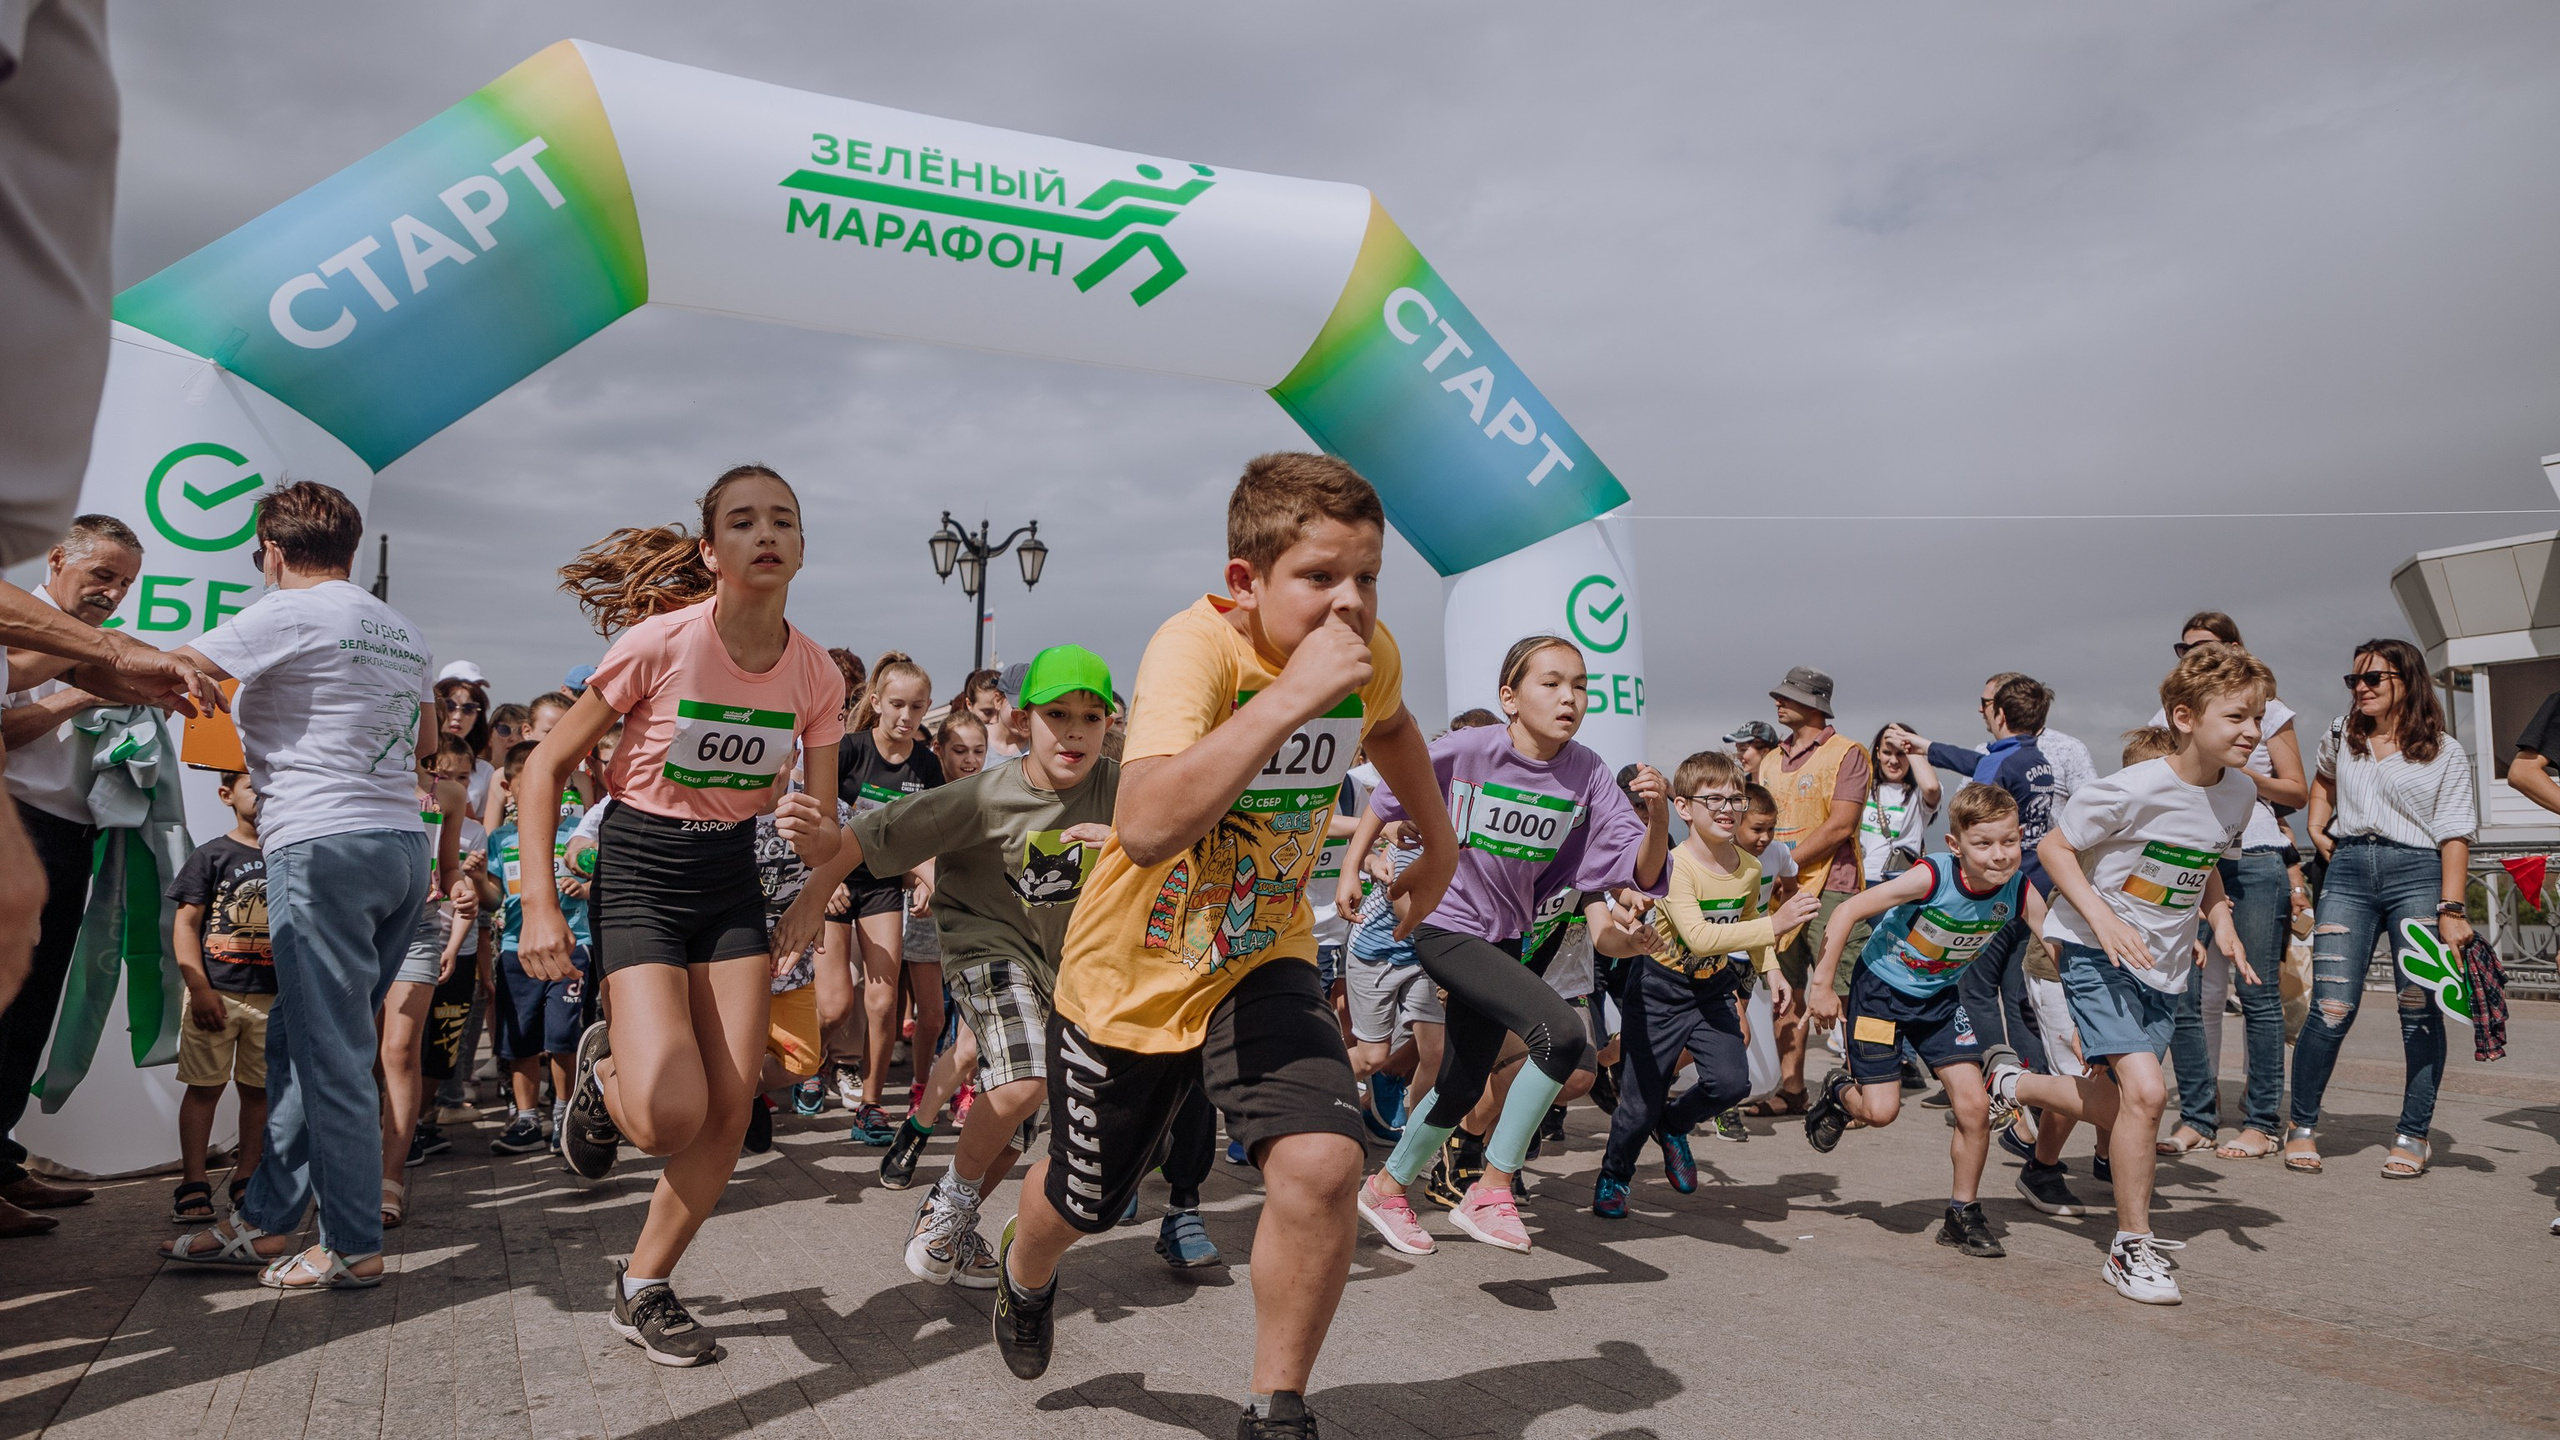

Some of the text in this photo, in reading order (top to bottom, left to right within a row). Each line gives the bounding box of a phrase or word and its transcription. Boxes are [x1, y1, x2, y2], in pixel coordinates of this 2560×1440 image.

[810, 133, 1066, 206] ЗЕЛЁНЫЙ
[269, 135, 567, 349] СТАРТ
[786, 197, 1064, 276] МАРАФОН
[1383, 286, 1575, 488] СТАРТ
[102, 575, 254, 633] БЕ
[339, 639, 389, 656] ЗЕЛЁНЫЙ
[360, 619, 410, 643] СУДЬЯ
[1586, 673, 1645, 717] БЕР
[697, 732, 765, 765] 600
[1262, 732, 1336, 775] 120
[682, 774, 702, 784] СБЕР
[1256, 797, 1282, 808] СБЕР
[1277, 810, 1310, 829] CAFE
[1485, 806, 1557, 841] 1000
[234, 860, 264, 878] AND
[2176, 871, 2207, 888] 042
[1952, 936, 1984, 947] 022
[1061, 1024, 1108, 1221] FREESTY
